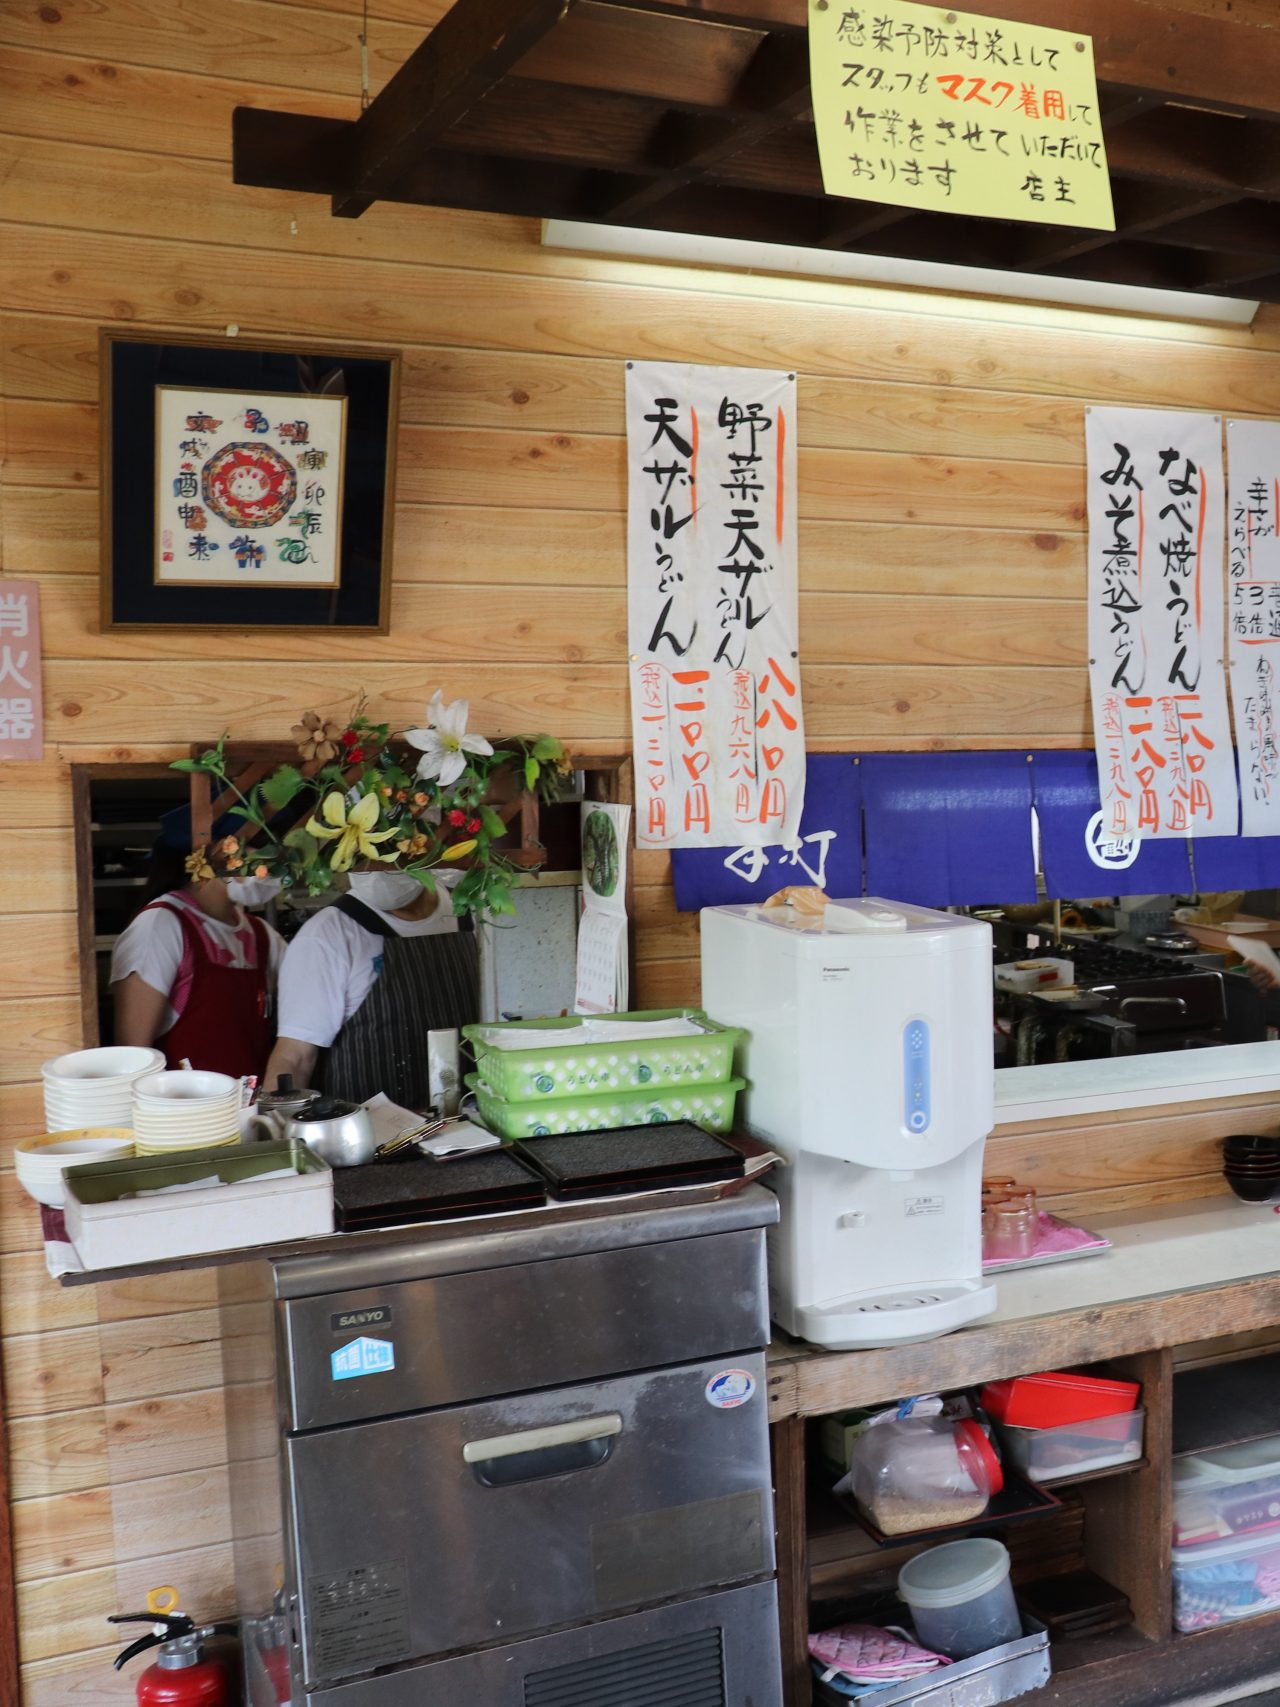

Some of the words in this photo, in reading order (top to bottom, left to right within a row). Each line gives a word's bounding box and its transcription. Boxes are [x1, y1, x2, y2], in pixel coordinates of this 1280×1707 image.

[836, 8, 1060, 71] 感染予防対策として
[844, 105, 1101, 169] 作業をさせていただいて
[848, 152, 957, 196] おります
[1020, 170, 1076, 204] 店主
[643, 398, 706, 657] 天ザルうどん
[714, 396, 773, 670] 野菜天ザルうどん
[1230, 501, 1251, 578] えらべる
[1100, 443, 1145, 695] みそ煮込うどん
[1158, 447, 1201, 693] なべ焼うどん
[339, 1311, 384, 1326] SANYO
